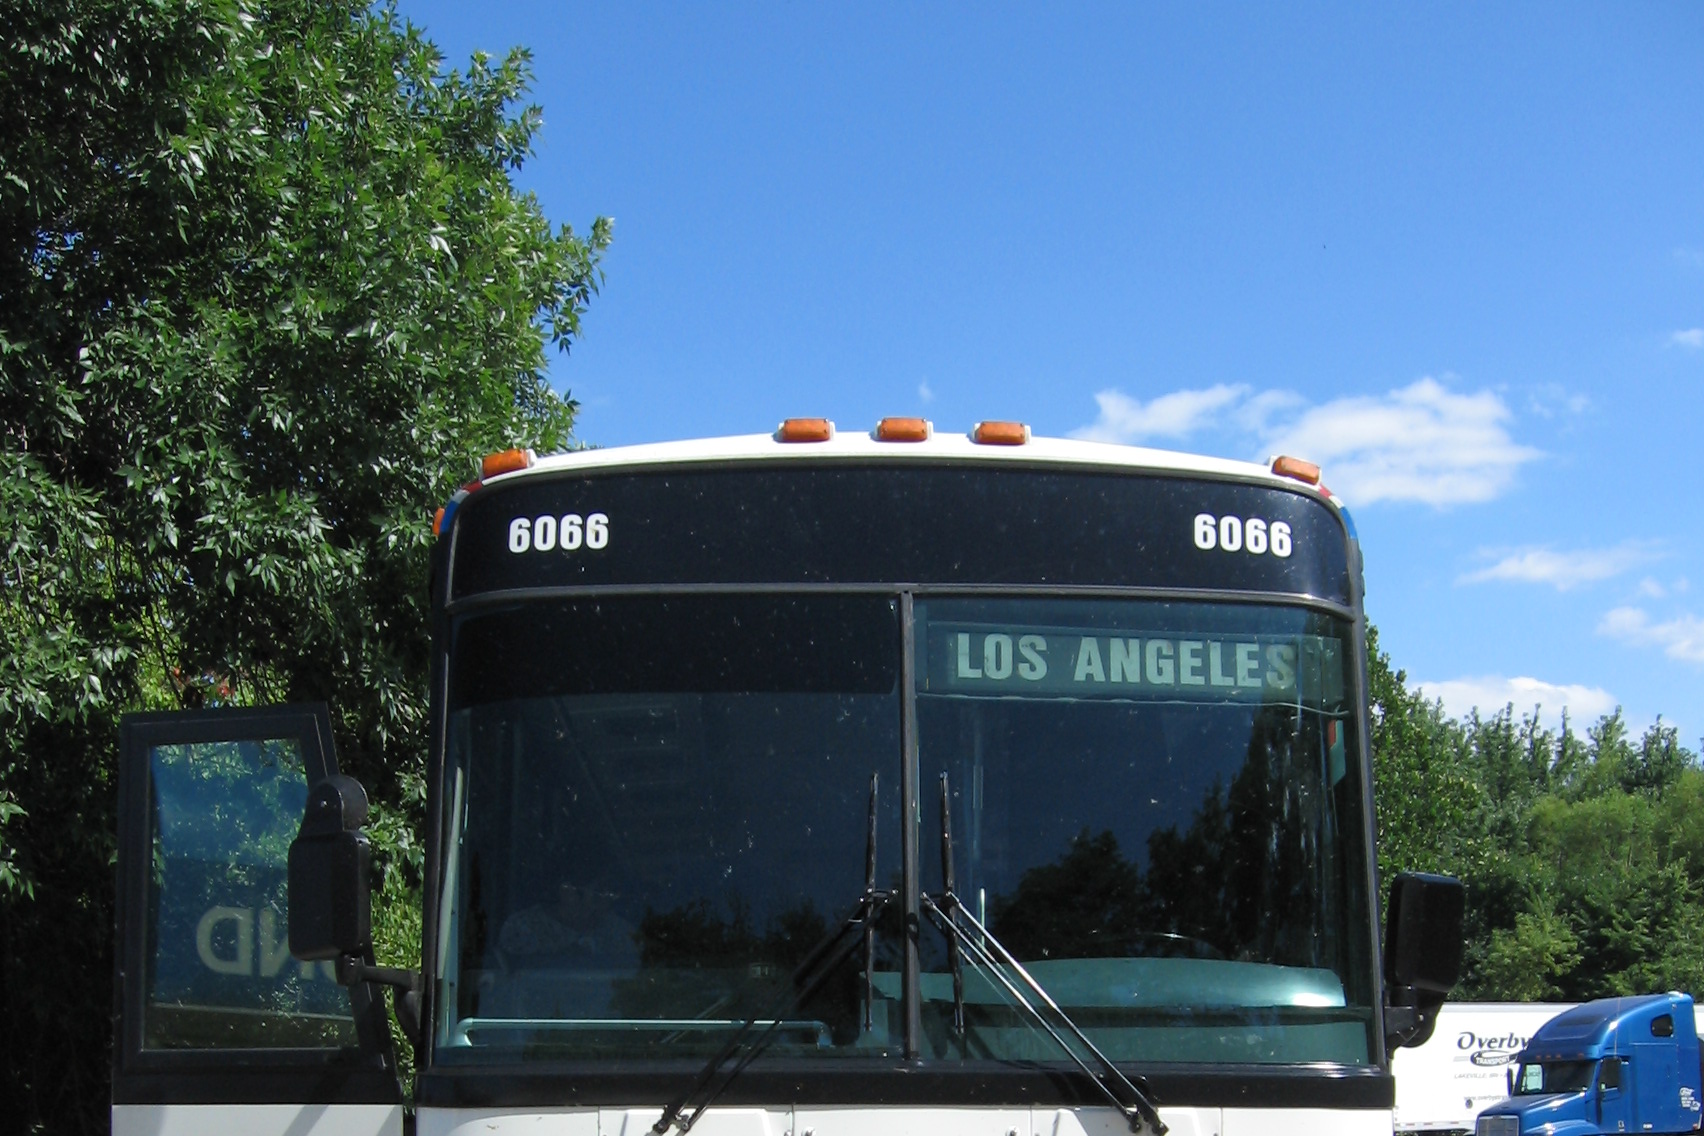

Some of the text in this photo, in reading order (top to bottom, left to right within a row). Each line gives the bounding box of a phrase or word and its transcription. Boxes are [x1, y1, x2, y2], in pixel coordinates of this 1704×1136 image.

[508, 513, 609, 553] 6066
[1194, 513, 1292, 557] 6066
[957, 633, 1296, 689] LOS ANGELES
